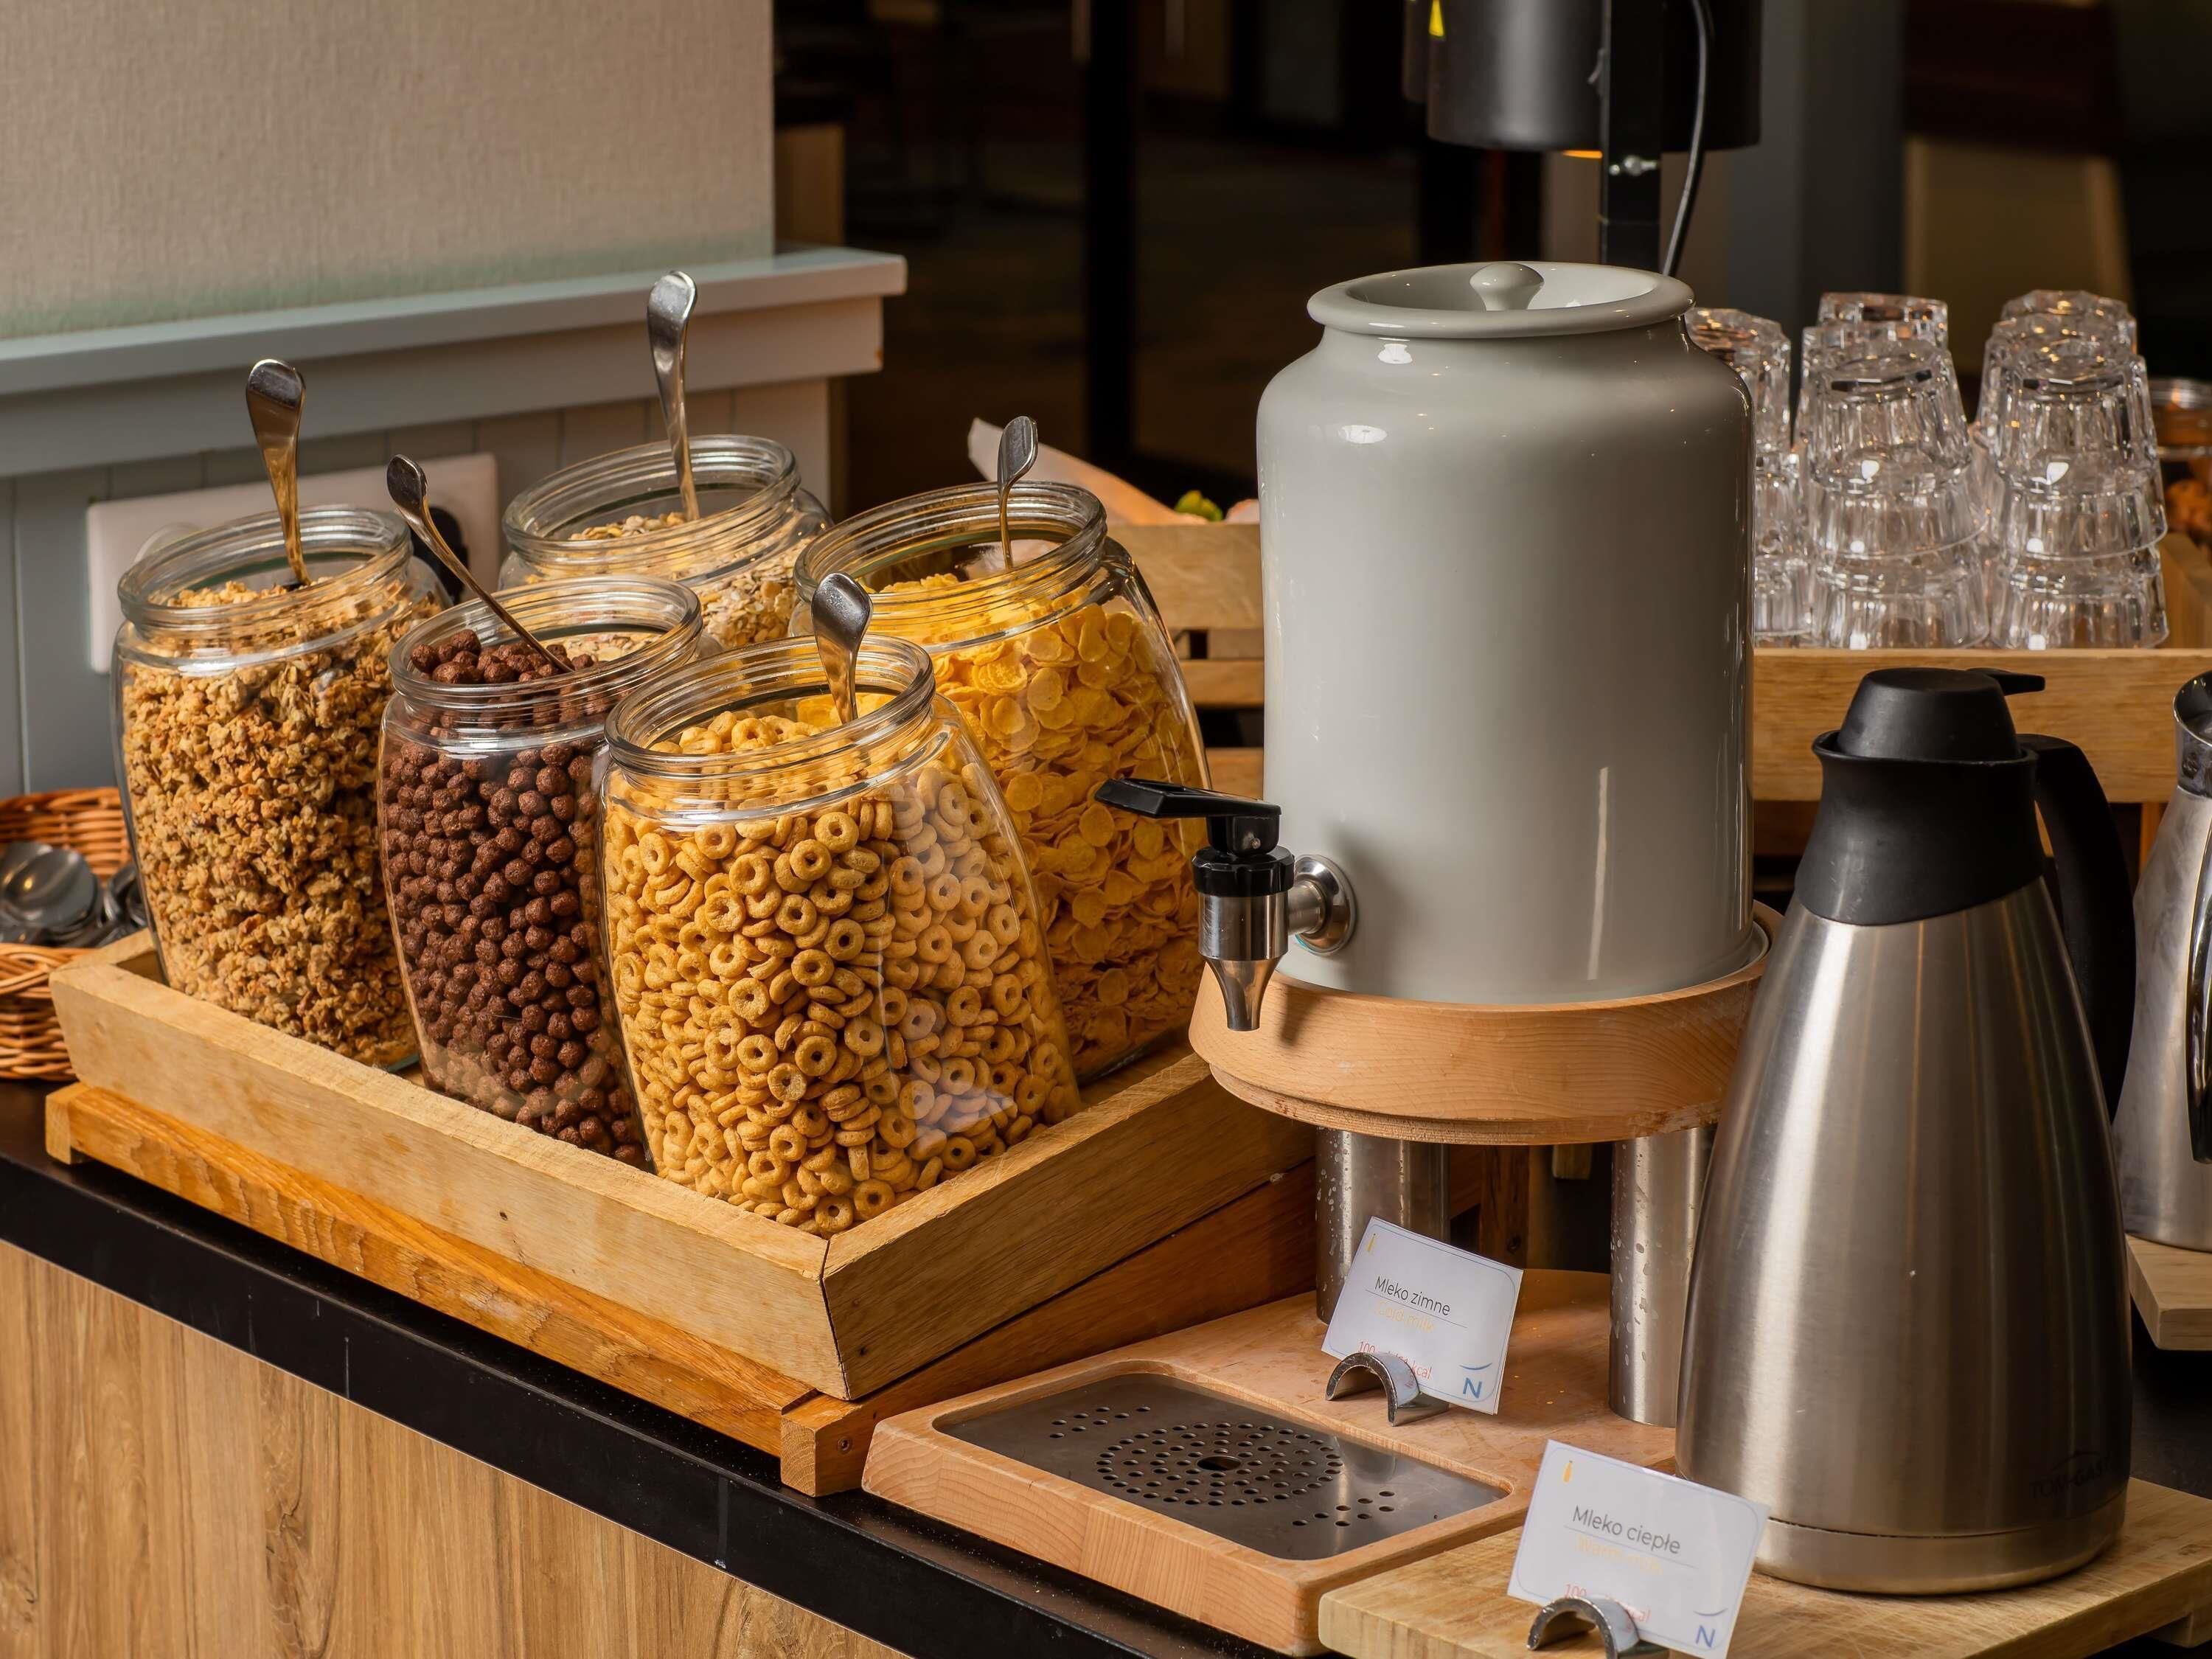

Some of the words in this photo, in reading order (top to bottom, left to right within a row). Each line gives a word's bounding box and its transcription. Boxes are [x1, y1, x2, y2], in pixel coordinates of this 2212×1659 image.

[1374, 1276, 1408, 1300] Mleko
[1411, 1292, 1450, 1315] zimne
[1463, 1377, 1483, 1399] N
[1572, 1505, 1622, 1536] Mleko
[1627, 1525, 1681, 1554] ciepłe
[1695, 1625, 1716, 1648] N
